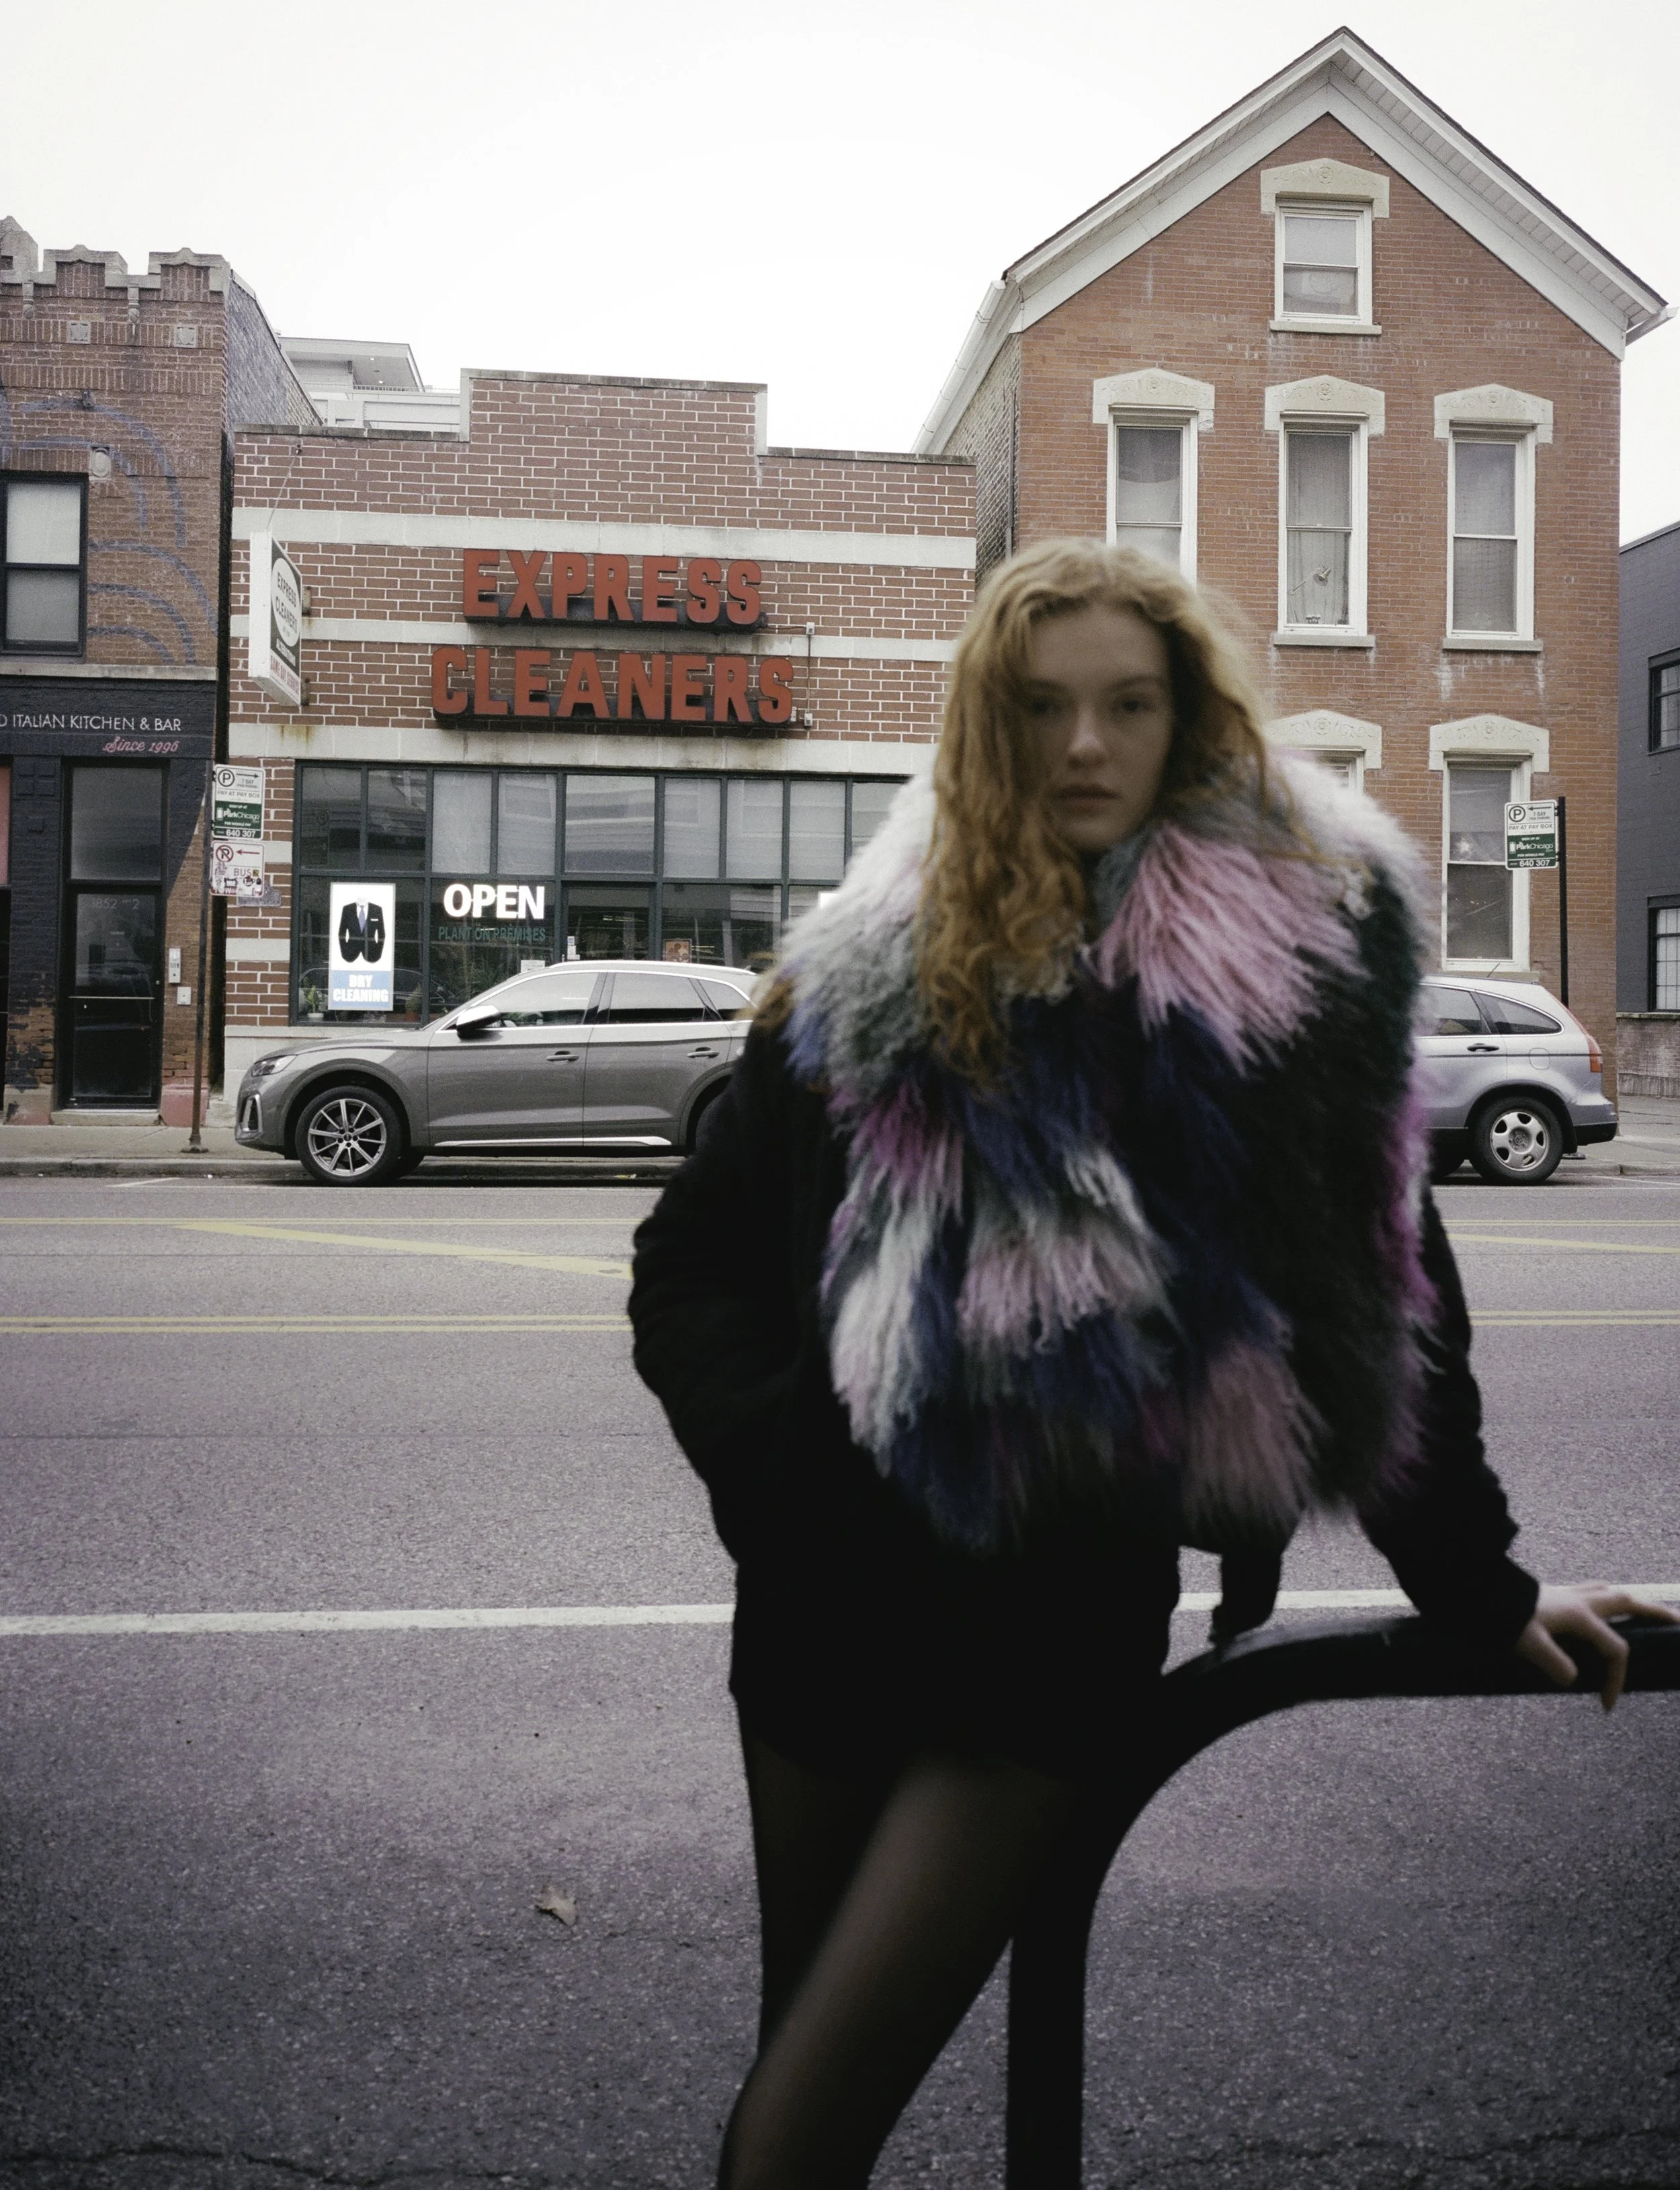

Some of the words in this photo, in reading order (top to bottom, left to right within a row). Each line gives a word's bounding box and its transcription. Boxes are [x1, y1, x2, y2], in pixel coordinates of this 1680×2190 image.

[277, 571, 296, 608] EXPRESS
[463, 549, 761, 625] EXPRESS
[275, 596, 298, 633] CLEANERS
[431, 646, 794, 724] CLEANERS
[13, 714, 65, 728] ITALIAN
[70, 715, 135, 731] KITCHEN
[140, 717, 151, 731] &
[155, 718, 181, 731] BAR
[103, 736, 145, 753] Since
[224, 809, 260, 820] ParkChicago
[226, 829, 241, 837] 640
[242, 829, 256, 838] 307
[1516, 842, 1554, 851] ParkChicago
[444, 883, 545, 920] OPEN
[438, 926, 471, 940] PLANT
[475, 926, 491, 940] ON
[494, 927, 546, 942] PREMISES
[349, 975, 373, 987] DRY
[333, 988, 388, 1002] CLEANING
